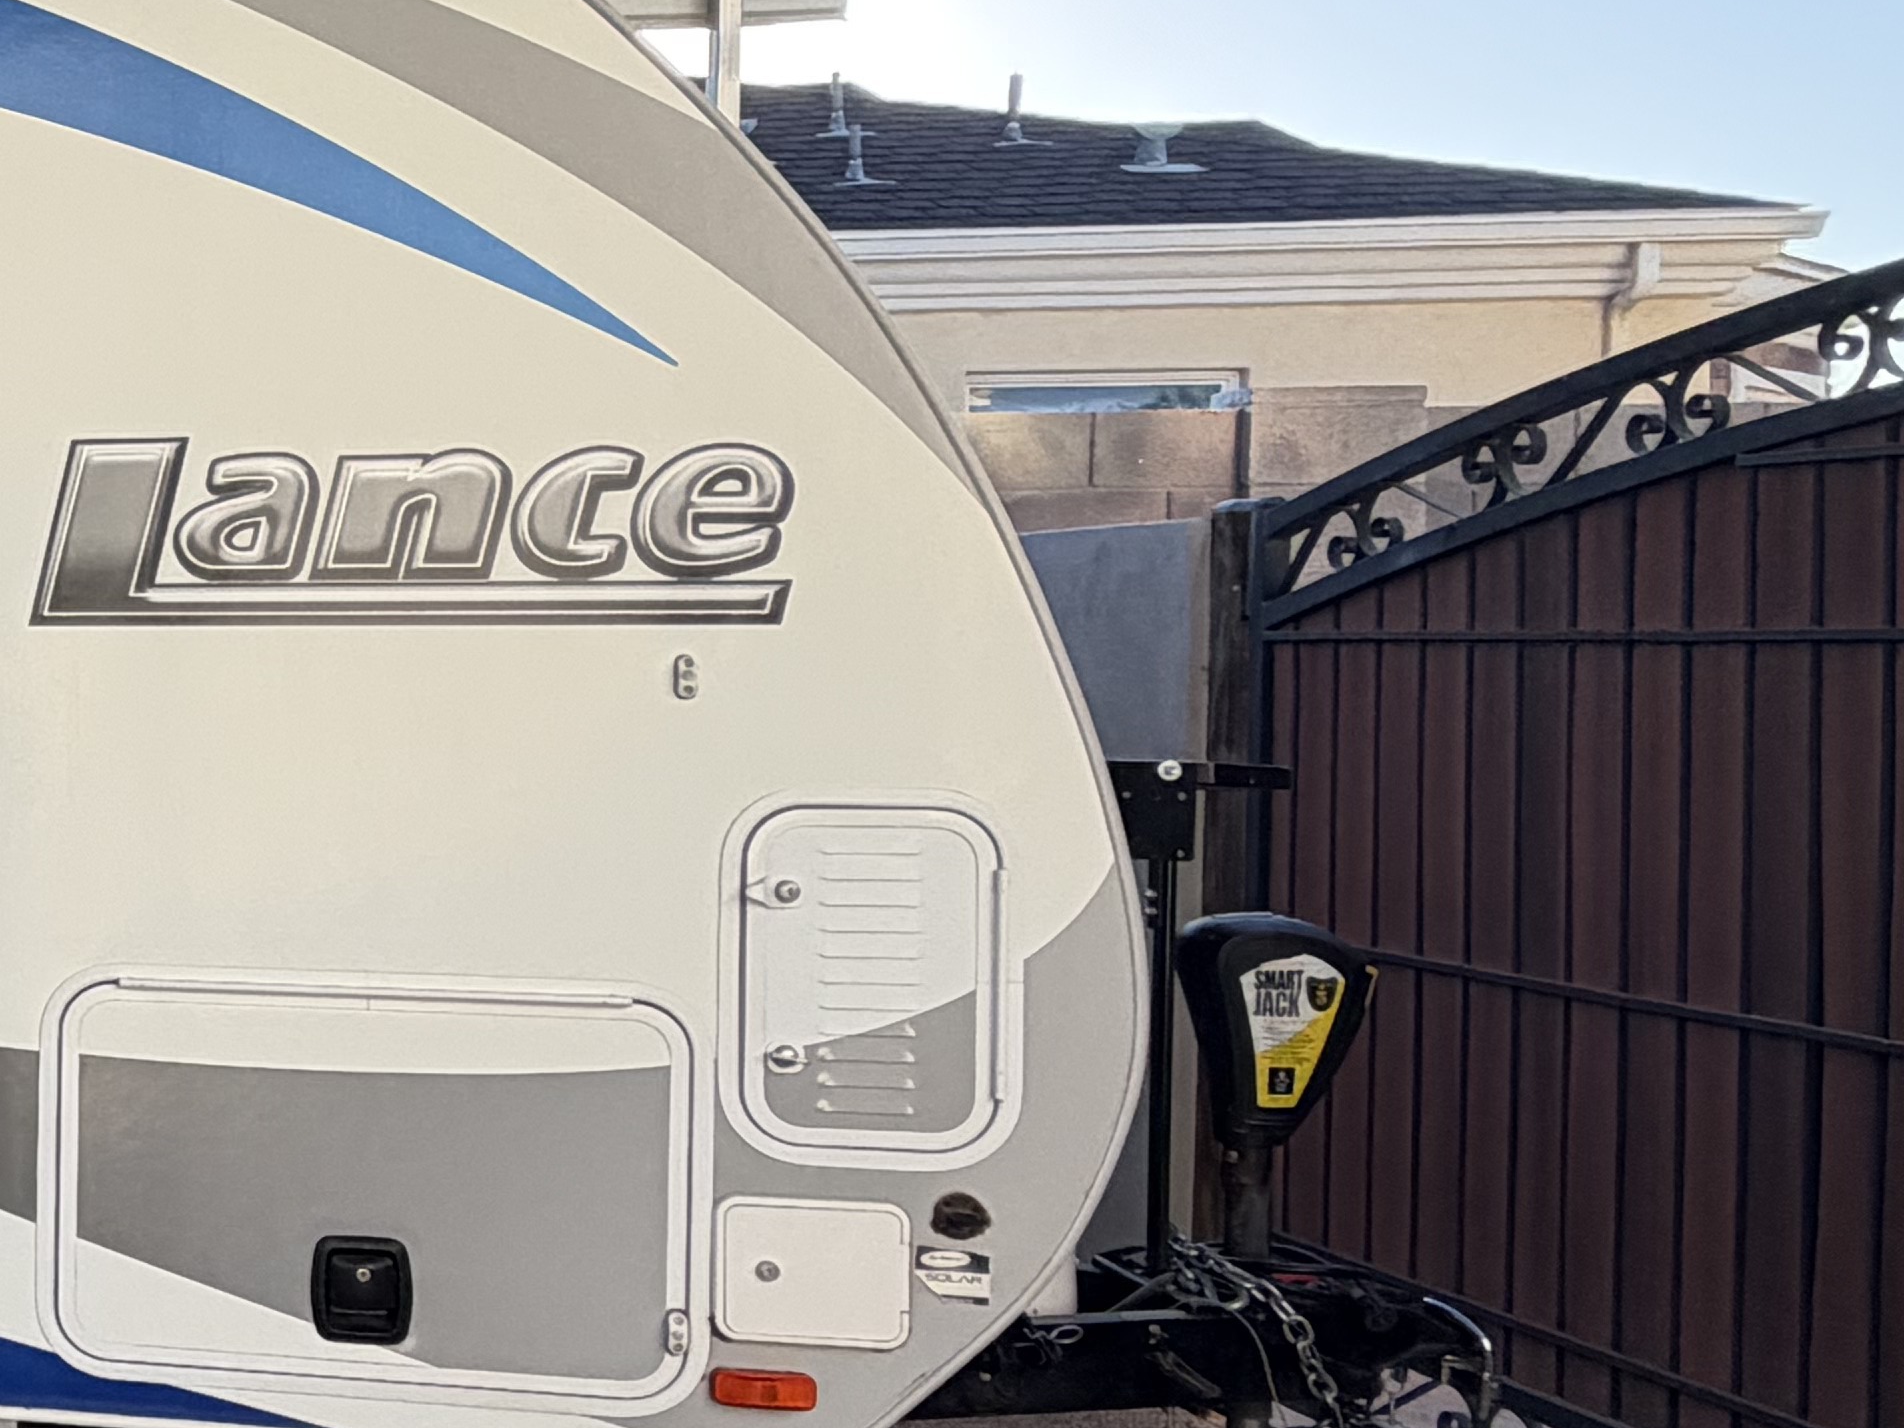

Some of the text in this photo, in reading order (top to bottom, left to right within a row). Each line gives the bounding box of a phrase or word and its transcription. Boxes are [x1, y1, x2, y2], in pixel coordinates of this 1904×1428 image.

[28, 436, 797, 626] Lance
[1254, 970, 1304, 990] SMART
[1253, 990, 1301, 1018] JACK
[925, 1274, 983, 1285] SOLAR
